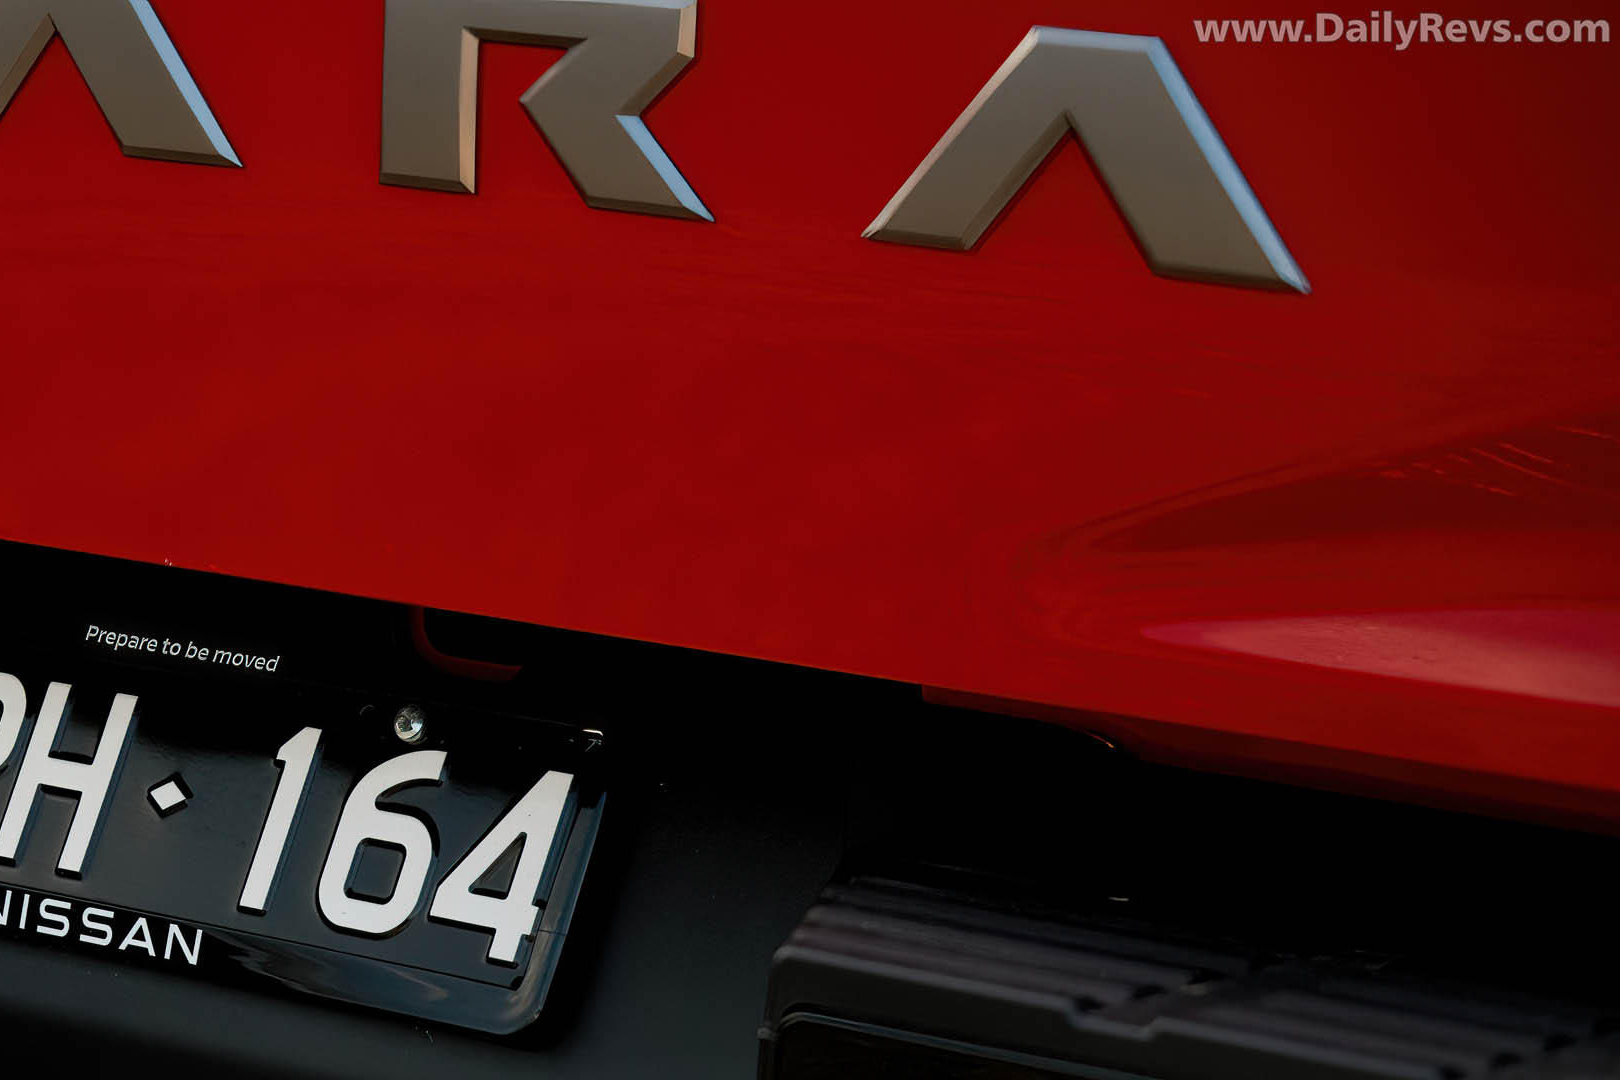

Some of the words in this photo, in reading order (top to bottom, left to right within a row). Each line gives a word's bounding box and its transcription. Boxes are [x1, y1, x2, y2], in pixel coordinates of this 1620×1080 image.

[85, 624, 158, 651] Prepare
[162, 638, 182, 656] to
[184, 641, 210, 661] be
[212, 649, 281, 672] moved
[238, 726, 575, 963] 164
